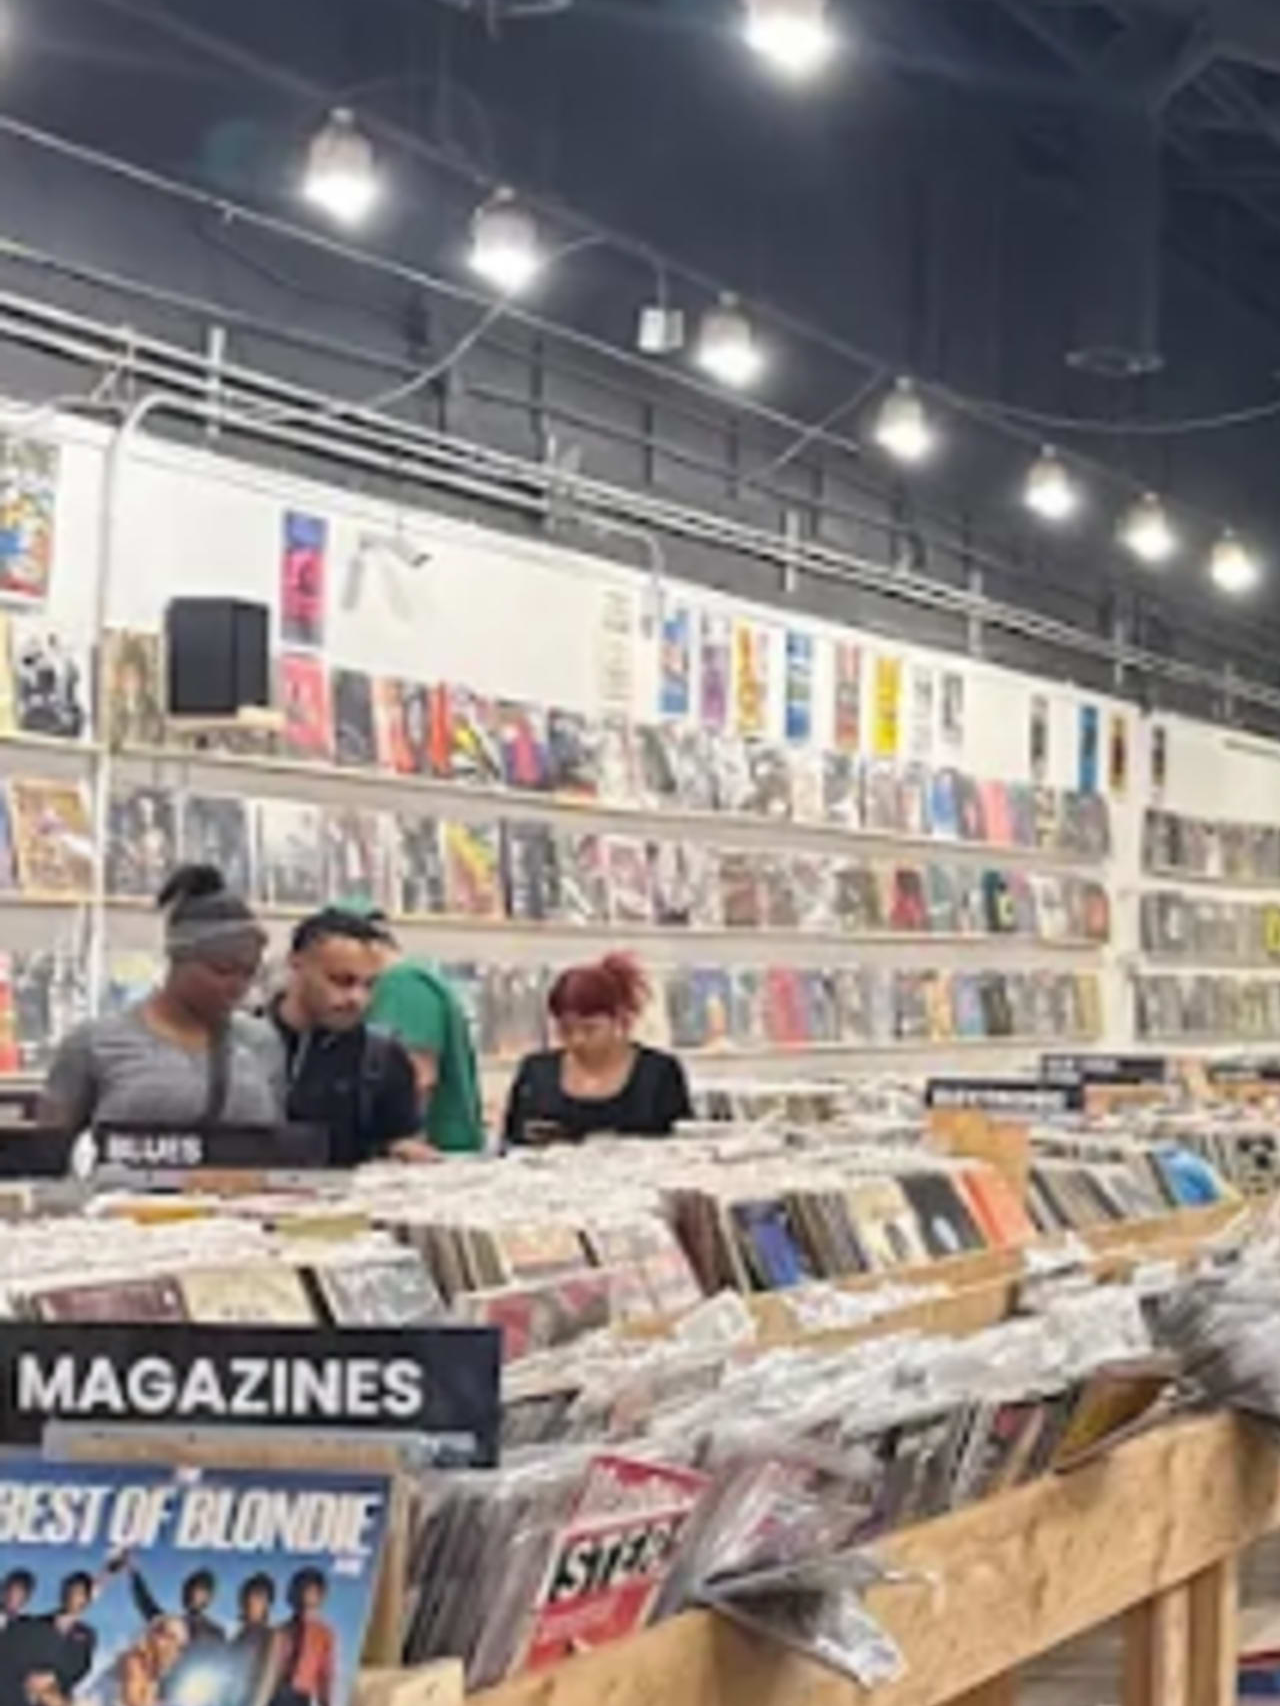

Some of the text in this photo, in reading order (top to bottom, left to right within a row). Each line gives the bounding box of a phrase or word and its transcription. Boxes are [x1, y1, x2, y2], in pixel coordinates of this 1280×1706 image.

[108, 1133, 203, 1165] BLUES
[16, 1353, 424, 1417] MAGAZINES
[0, 1482, 384, 1557] BEST OF BLONDIE
